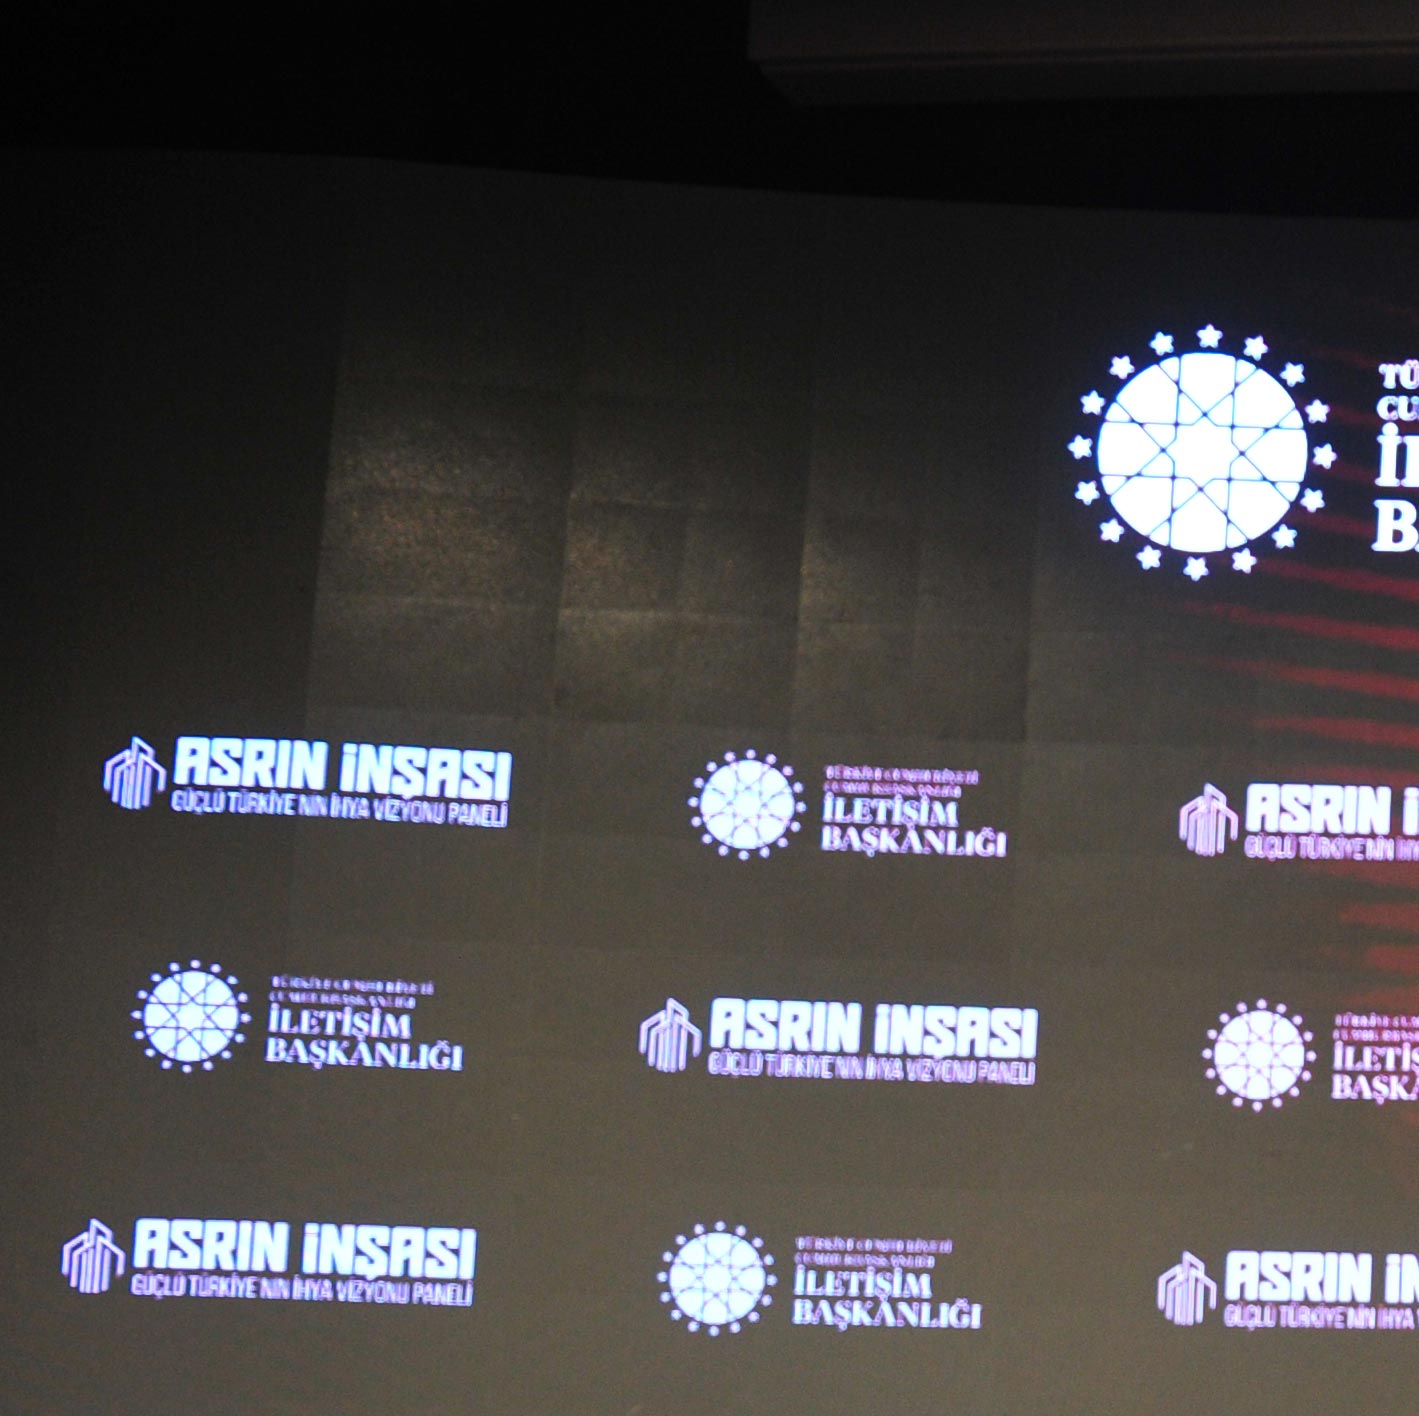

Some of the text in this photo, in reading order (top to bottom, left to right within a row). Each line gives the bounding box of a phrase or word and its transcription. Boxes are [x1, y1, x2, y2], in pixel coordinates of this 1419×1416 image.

[173, 736, 328, 792] ASRIN
[1245, 784, 1391, 835] ASRIN
[268, 1003, 413, 1041] İLETİŞİM
[709, 997, 862, 1053] ASRIN
[266, 1037, 464, 1070] BAŞKANLIĞI
[132, 1218, 289, 1273] ASRIN
[1224, 1251, 1372, 1303] ASRIN
